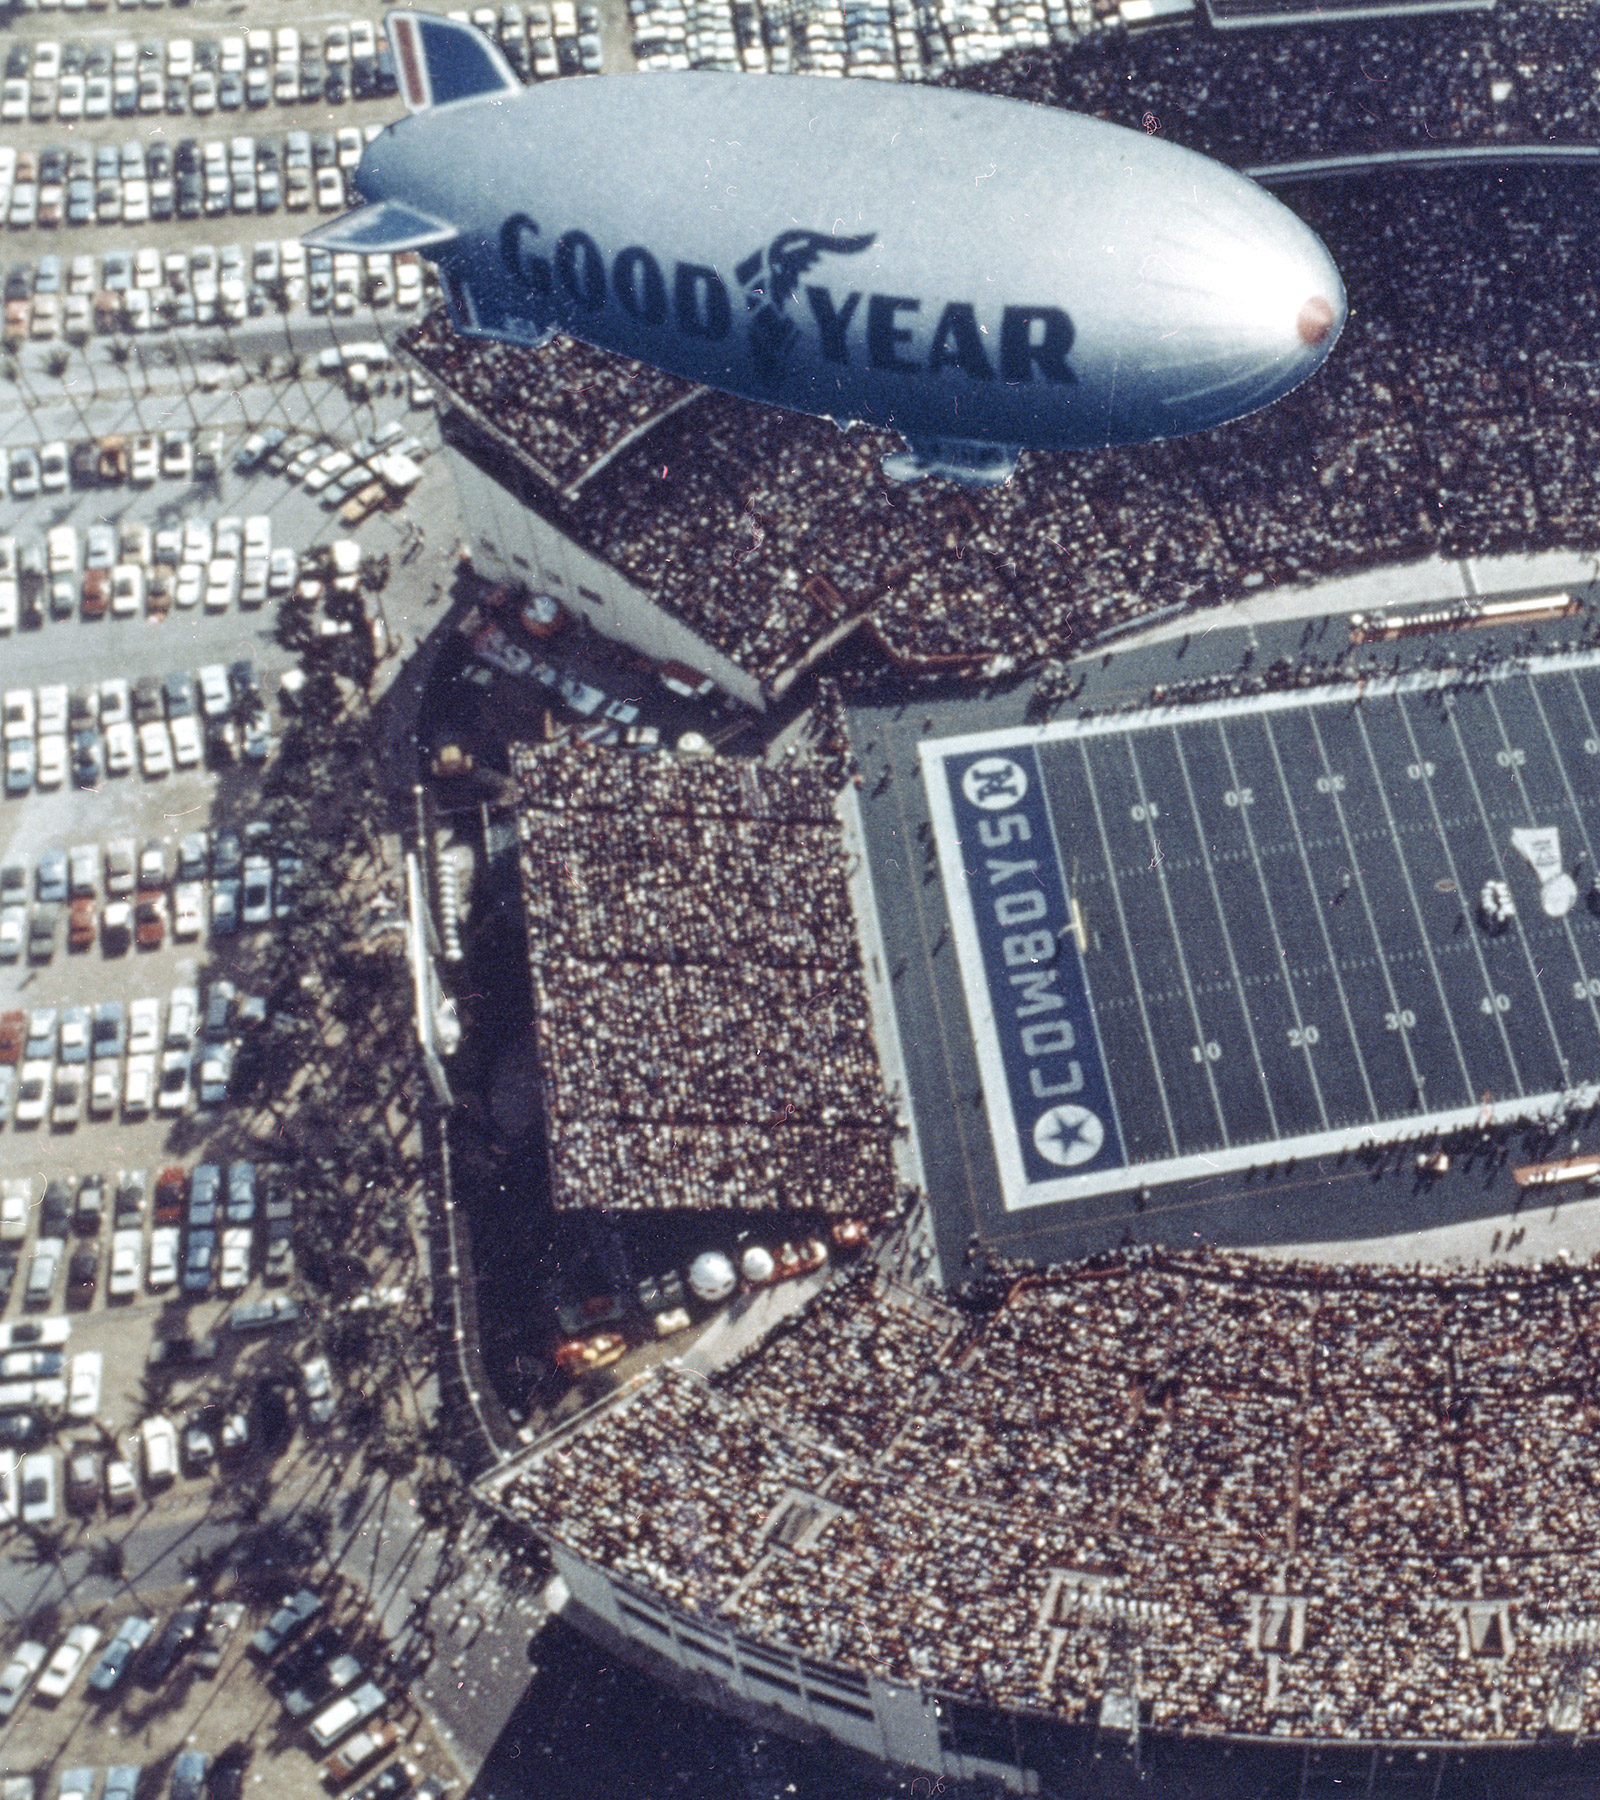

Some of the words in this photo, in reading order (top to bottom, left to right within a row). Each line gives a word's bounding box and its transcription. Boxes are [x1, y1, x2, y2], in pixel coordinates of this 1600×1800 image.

[498, 213, 733, 343] GOOD
[804, 286, 1081, 384] YEAR
[971, 764, 1020, 802] N
[977, 814, 1085, 1100] COWBOYS
[1480, 994, 1511, 1015] 40
[1385, 1009, 1417, 1031] 30
[1287, 1024, 1320, 1047] 20
[1191, 1041, 1222, 1064] 10
